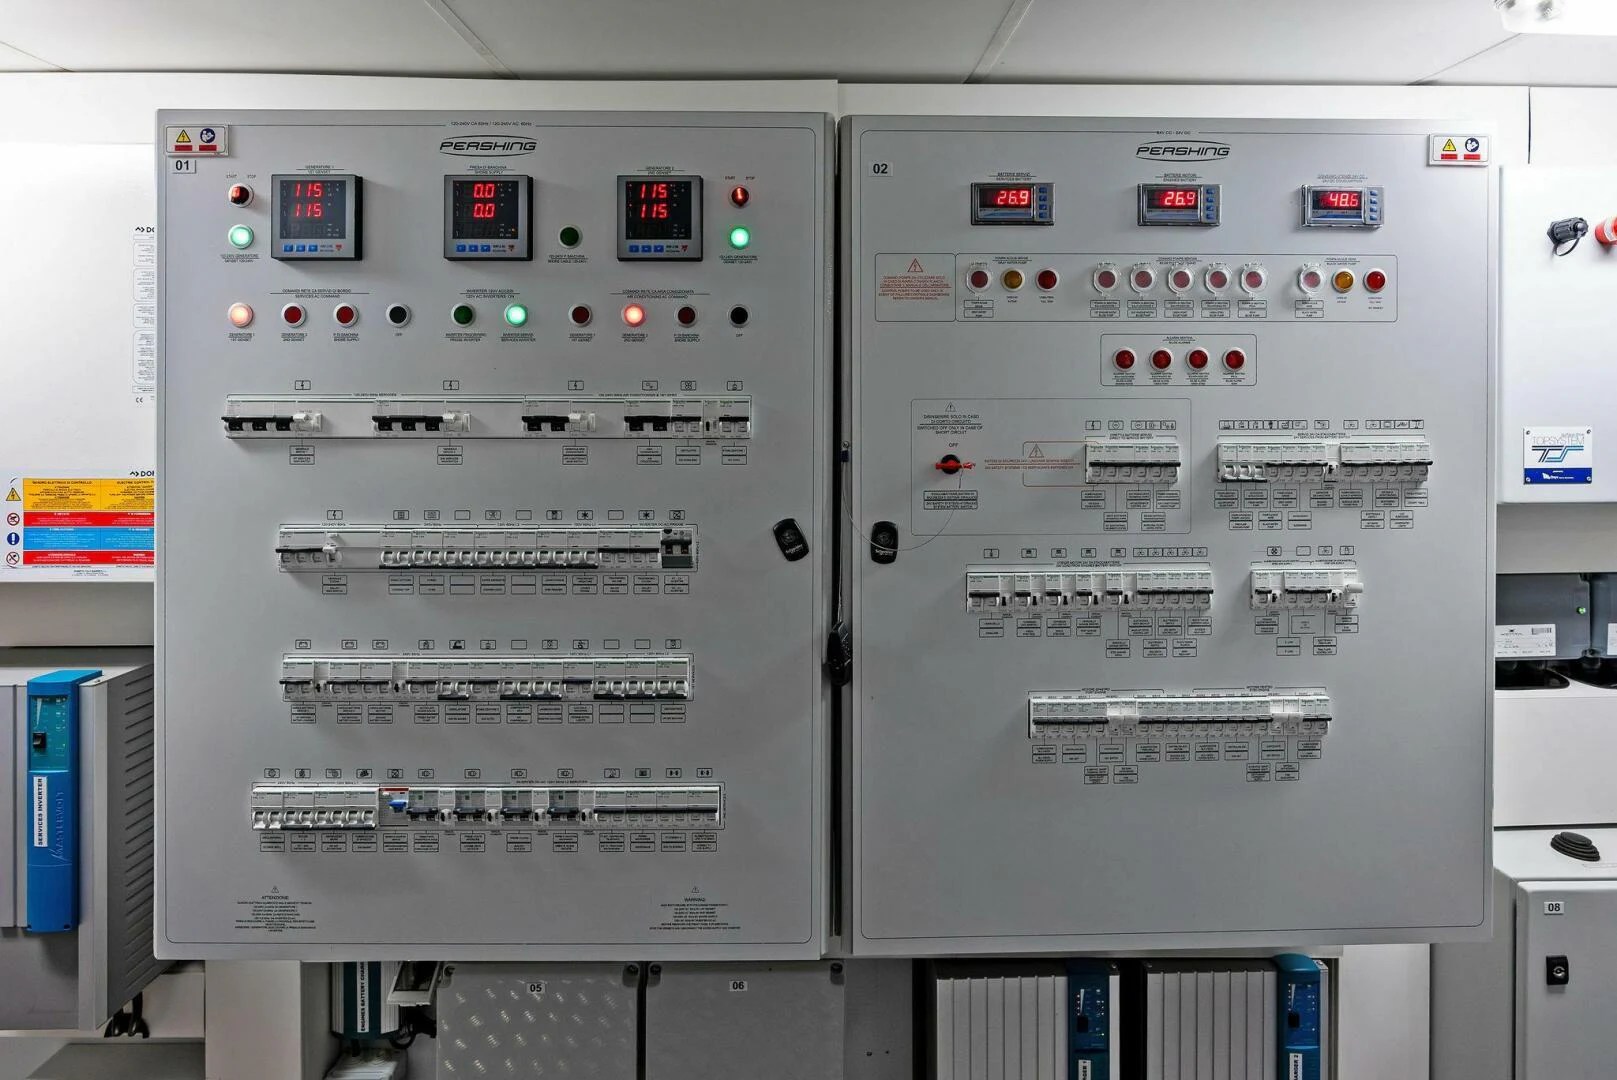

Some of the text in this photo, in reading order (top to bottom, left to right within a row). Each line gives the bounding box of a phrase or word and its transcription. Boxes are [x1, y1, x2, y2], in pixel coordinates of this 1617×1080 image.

[440, 142, 537, 150] PERSHING
[1136, 146, 1230, 156] PERSHING
[175, 160, 190, 170] 01
[873, 164, 888, 174] 02
[998, 190, 1028, 204] 26.9
[1165, 192, 1196, 205] 26.9
[1330, 193, 1358, 206] 48.6
[1548, 903, 1560, 912] 08
[530, 984, 542, 992] 05
[732, 981, 744, 990] 06
